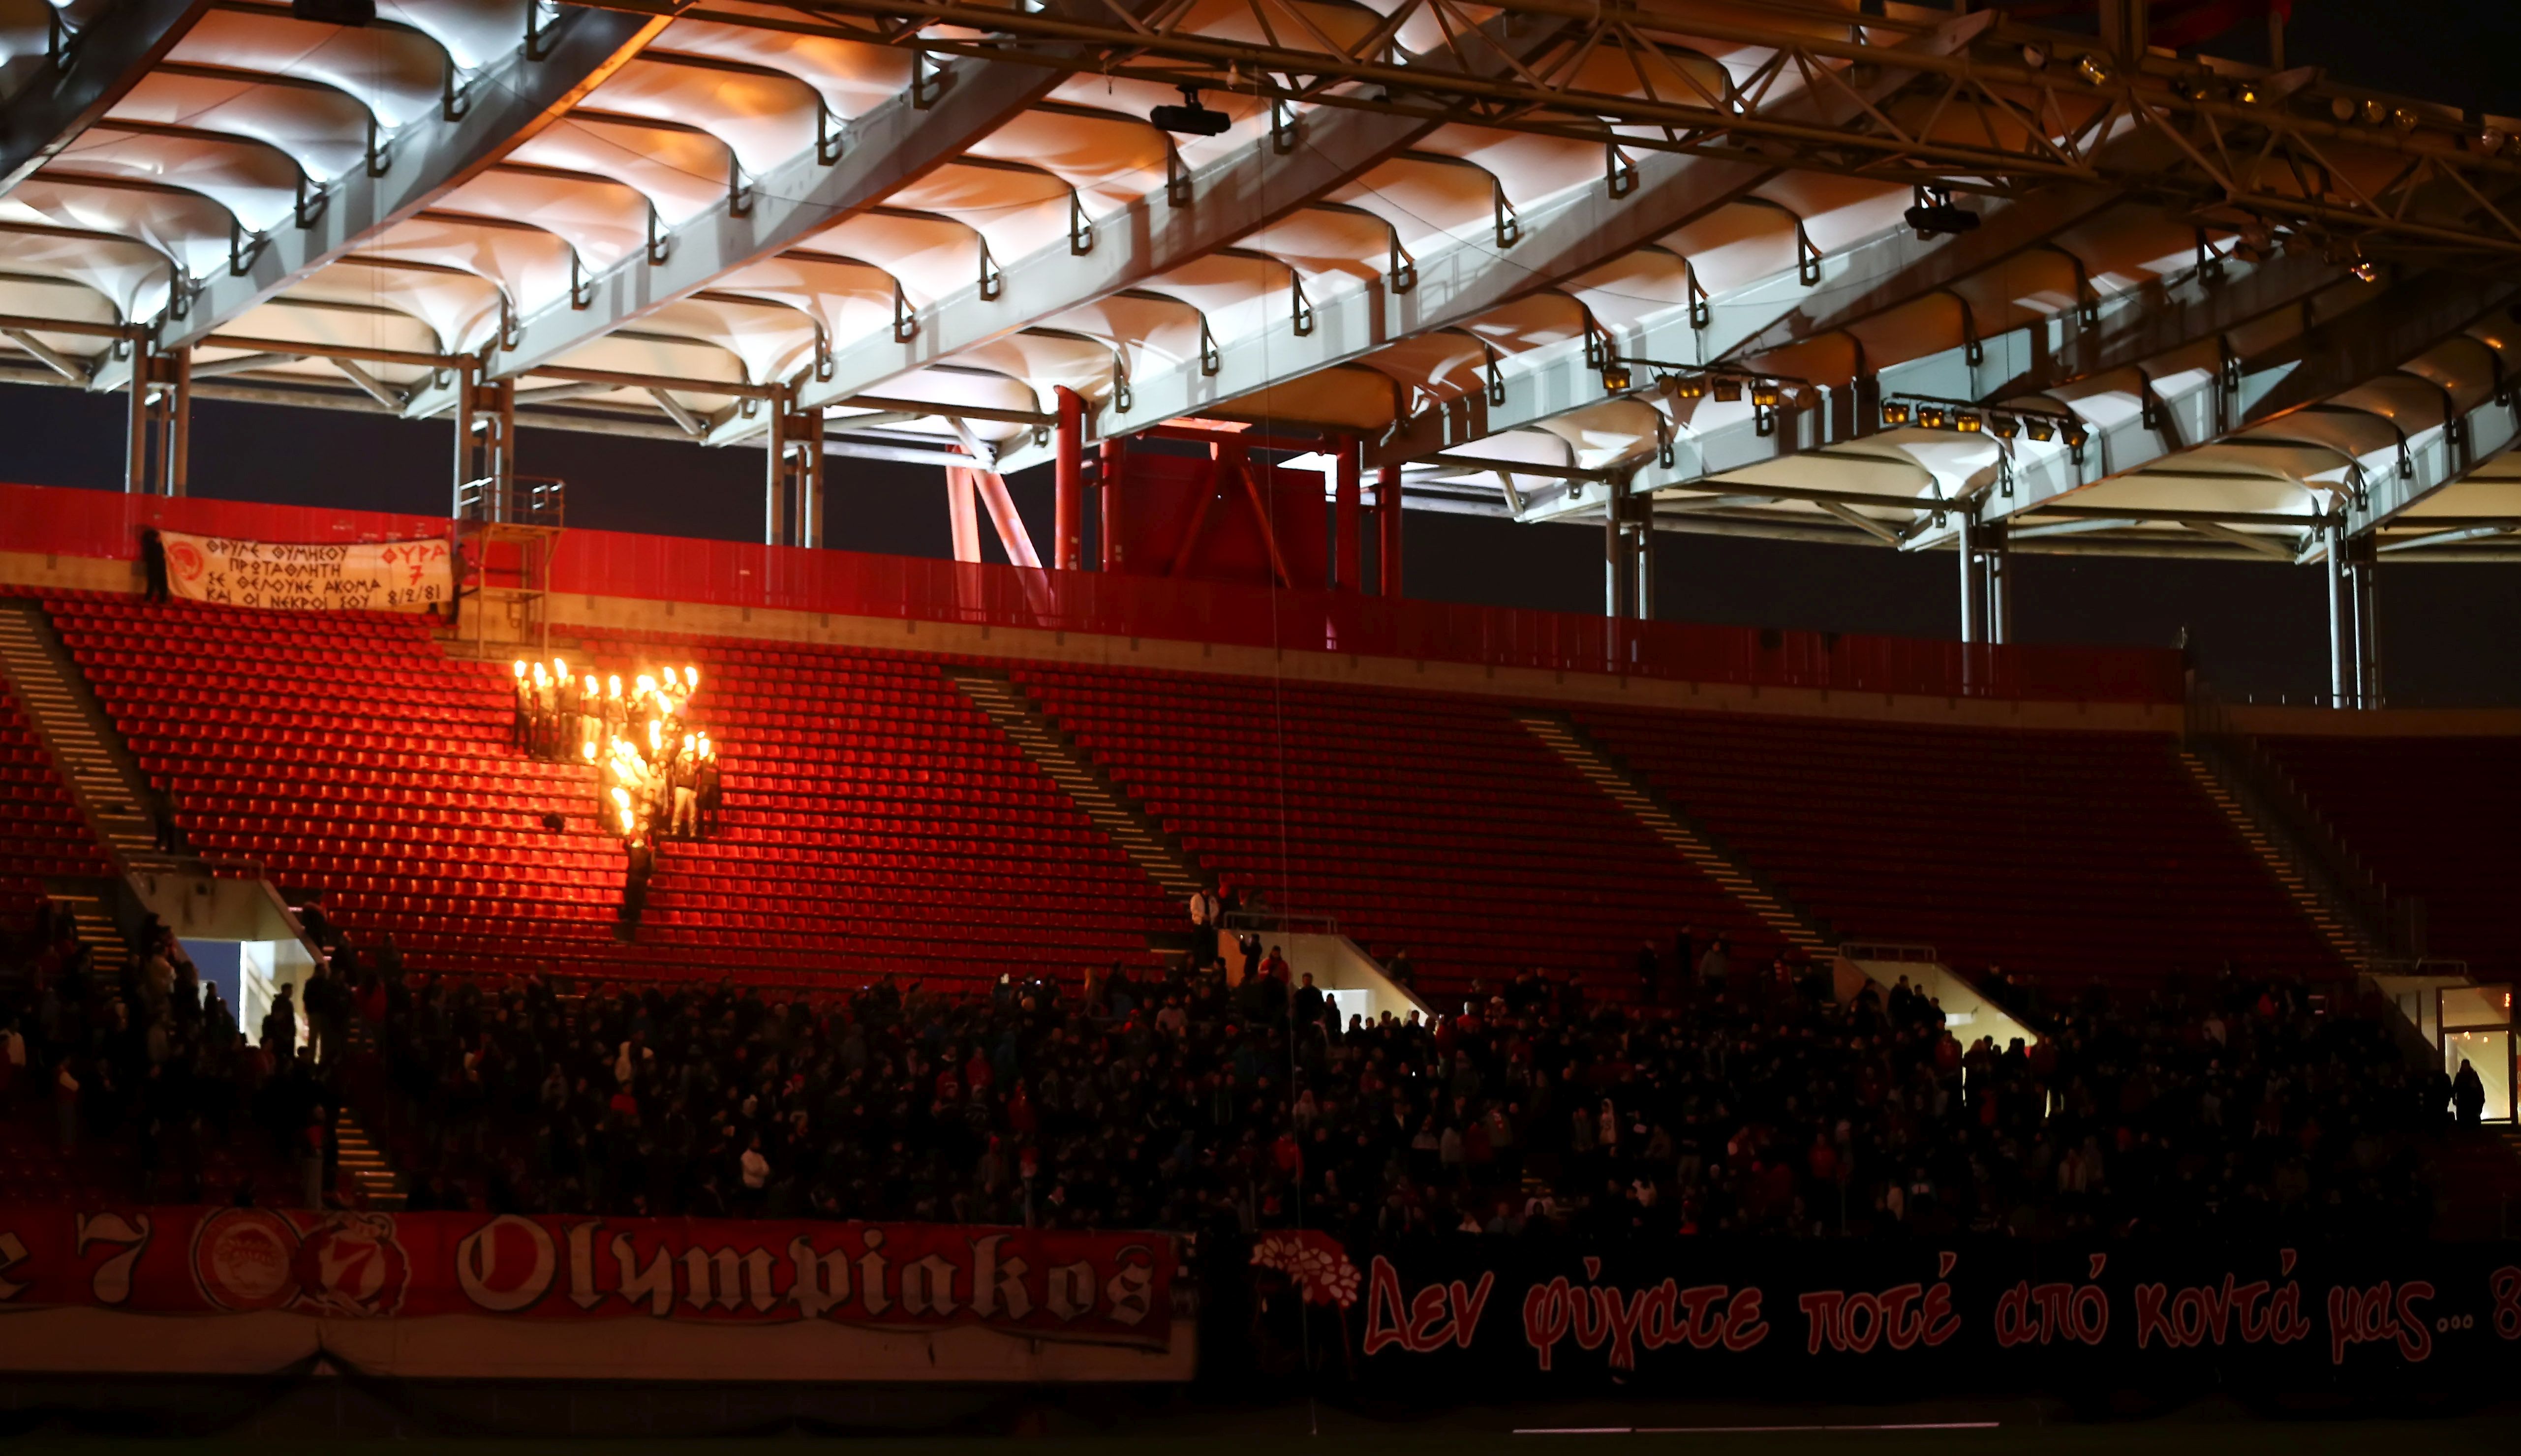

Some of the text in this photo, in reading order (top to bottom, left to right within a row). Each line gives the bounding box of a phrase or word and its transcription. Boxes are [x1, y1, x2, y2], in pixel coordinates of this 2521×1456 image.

[272, 545, 347, 562] ΘΥΜΗΣΟΥ
[382, 545, 447, 564] ΘΥΡΑ
[229, 557, 341, 578] ΠΡΩΤΑΘΛΗΤΗ
[409, 565, 424, 586] 7
[208, 571, 381, 594] ΣΕ ΘΕΛΟΥΝΕ ΑΚΟΜΑ
[206, 587, 369, 610] ΚΑΙ ΟΙ ΝΕΚΡΟΙ ΣΟΥ
[388, 584, 441, 607] 8/2/81
[76, 1212, 150, 1304] 7
[1364, 1255, 1494, 1355] Δεν
[1523, 1255, 1770, 1372] φύγατε
[1799, 1251, 1961, 1354] ποτέ
[1995, 1253, 2109, 1347] από
[2134, 1248, 2310, 1349] κοντά
